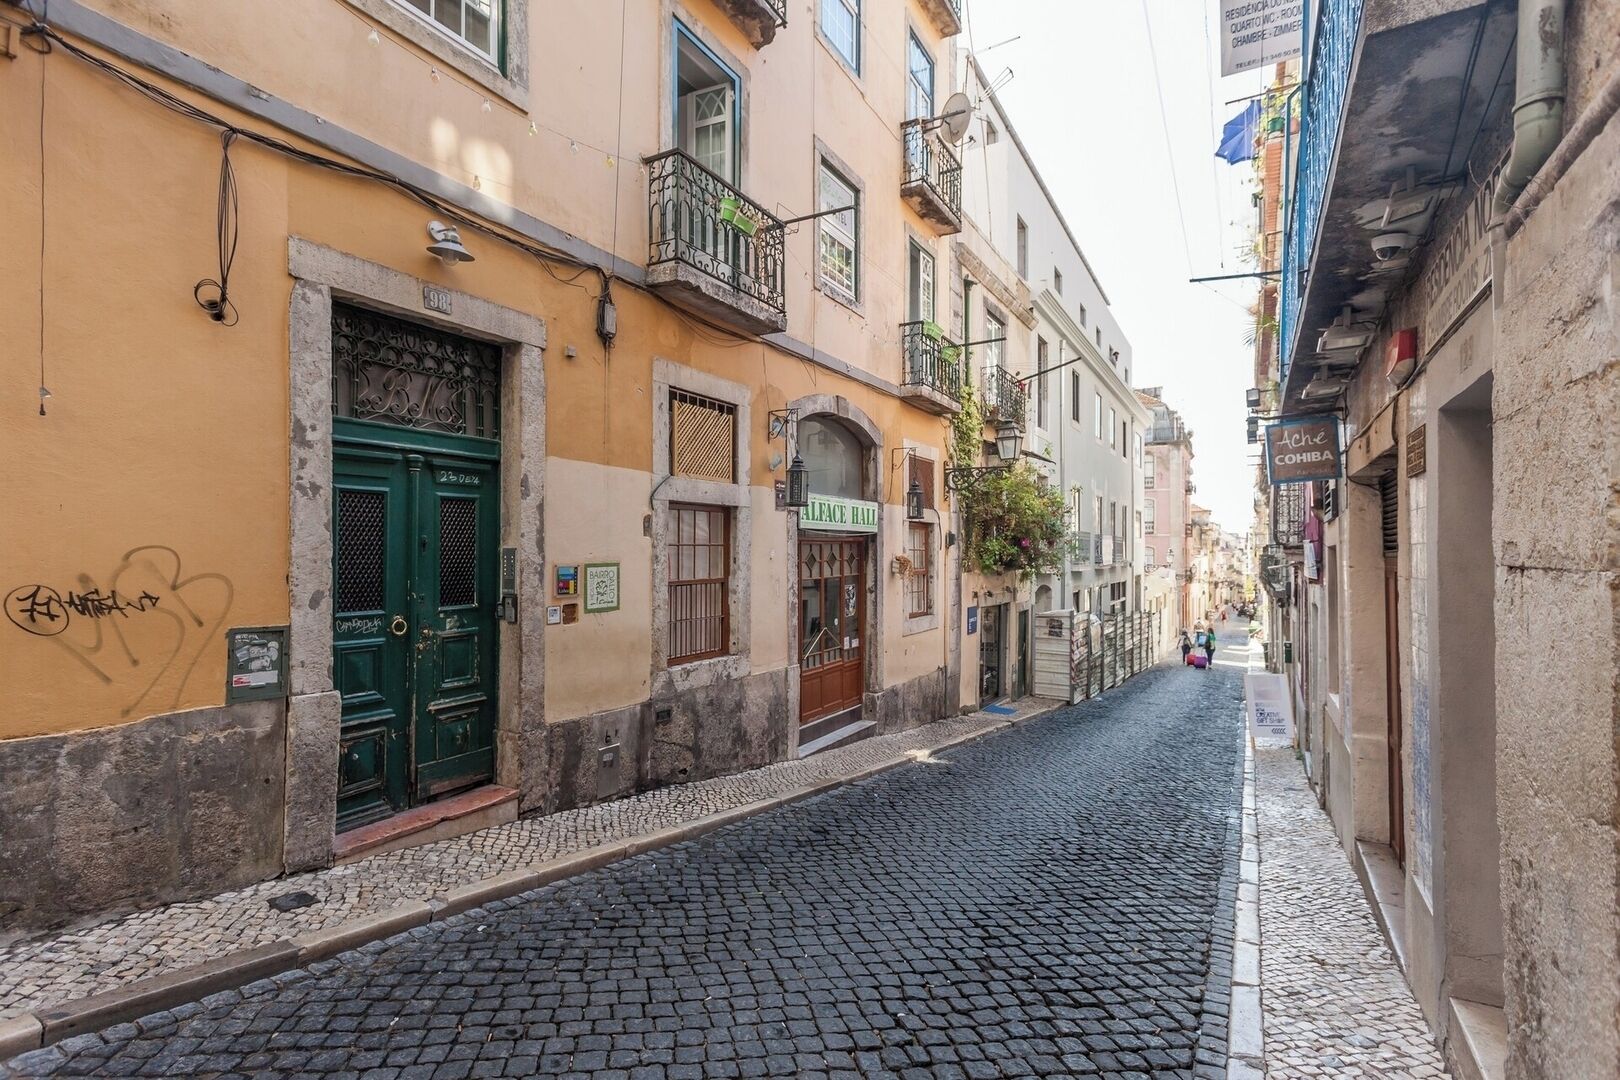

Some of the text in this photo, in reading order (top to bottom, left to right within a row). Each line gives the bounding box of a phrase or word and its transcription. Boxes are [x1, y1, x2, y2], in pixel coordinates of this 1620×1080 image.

[1230, 17, 1260, 34] QUARTO
[1232, 29, 1267, 48] CHAMBRE
[429, 291, 447, 310] 98
[1276, 427, 1328, 449] Aché
[1274, 450, 1334, 465] COHIBA
[801, 501, 878, 526] ALFACE HALL
[589, 569, 615, 580] BAIRRO
